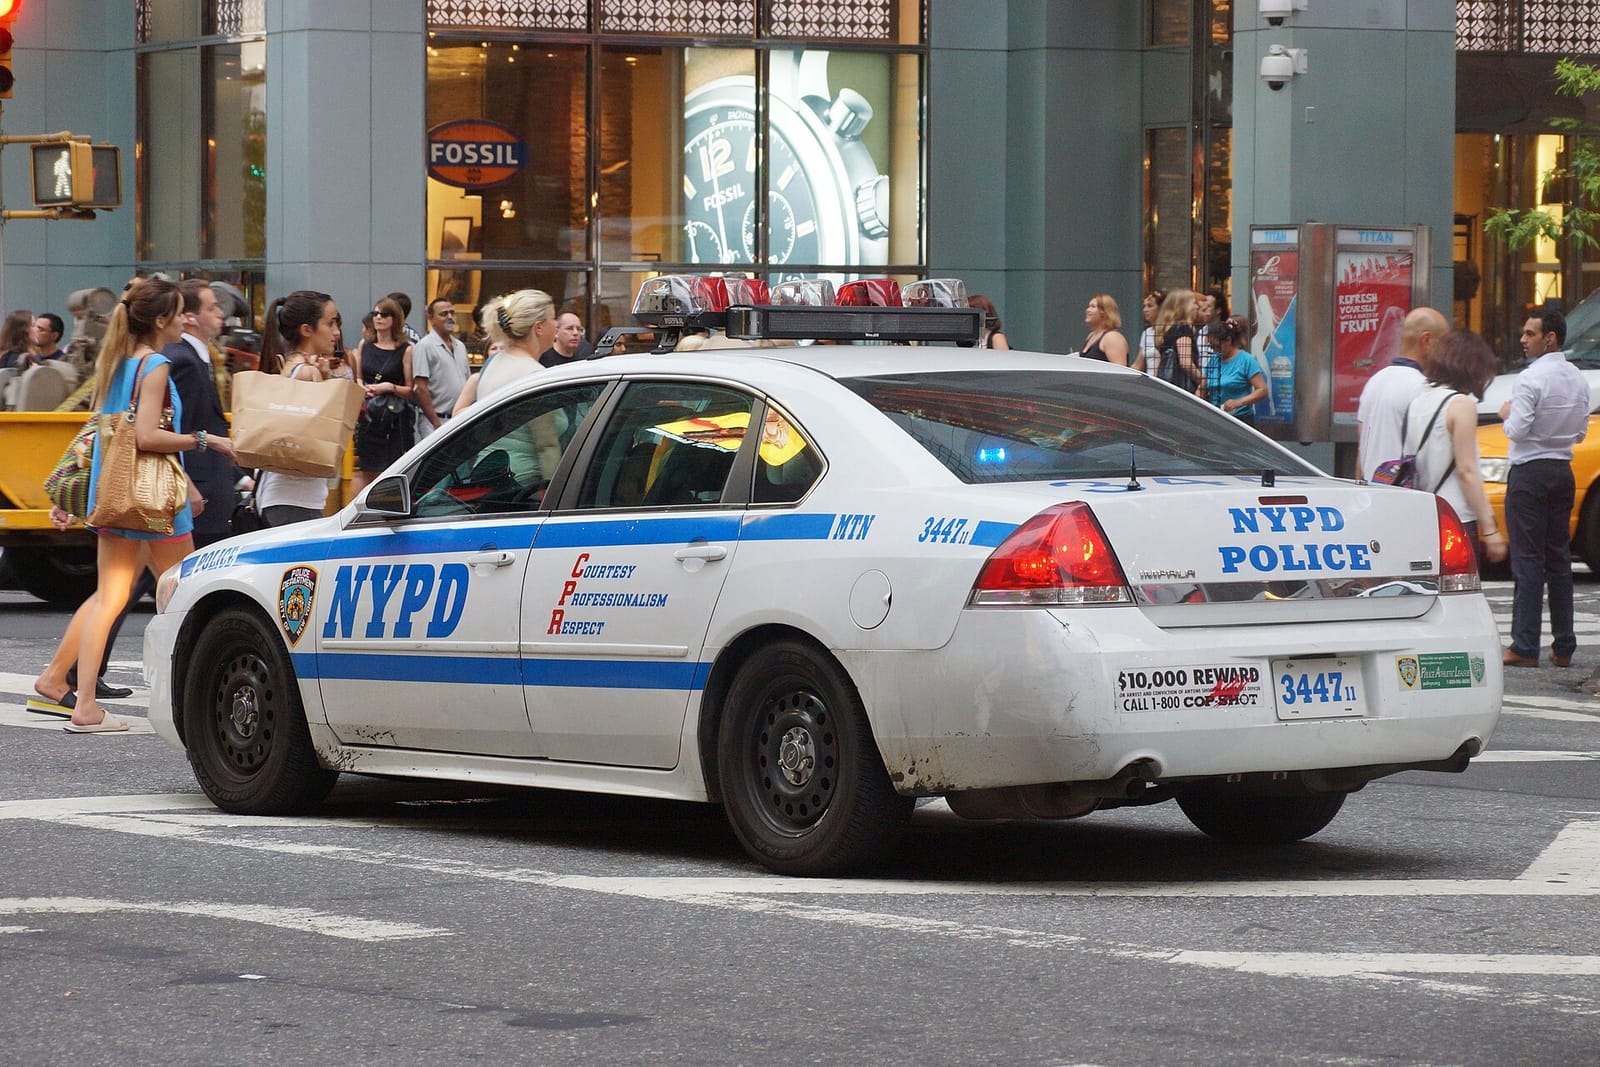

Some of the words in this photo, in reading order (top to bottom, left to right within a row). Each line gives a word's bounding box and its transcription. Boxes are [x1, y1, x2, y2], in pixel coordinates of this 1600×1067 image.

[430, 143, 519, 165] FOSSIL
[699, 138, 735, 183] 12
[703, 183, 745, 212] FOSSIL
[1358, 231, 1394, 243] TITAN
[1338, 293, 1378, 305] REFRESH
[1339, 304, 1379, 314] YOURSELF
[1340, 318, 1379, 333] FRUIT
[832, 513, 876, 541] MTN
[918, 516, 968, 544] 3447
[1228, 506, 1344, 534] NYPD
[193, 546, 239, 573] POLICE
[571, 553, 636, 579] COURTESY
[1218, 543, 1371, 574] POLICE
[281, 576, 315, 591] DEPARTMENT
[291, 568, 311, 579] POLICE
[1139, 569, 1196, 580] IMPALA
[322, 563, 470, 639] NYPD
[558, 580, 668, 607] PROFESSIONALISM
[283, 621, 290, 631] OF
[296, 618, 305, 636] NEW
[304, 596, 313, 616] YORK
[547, 609, 605, 635] RESPECT
[1118, 670, 1188, 691] $10,000
[1193, 667, 1260, 686] REWARD
[1280, 671, 1343, 705] 3447
[1123, 697, 1149, 711] CALL
[1151, 696, 1180, 710] 1-800
